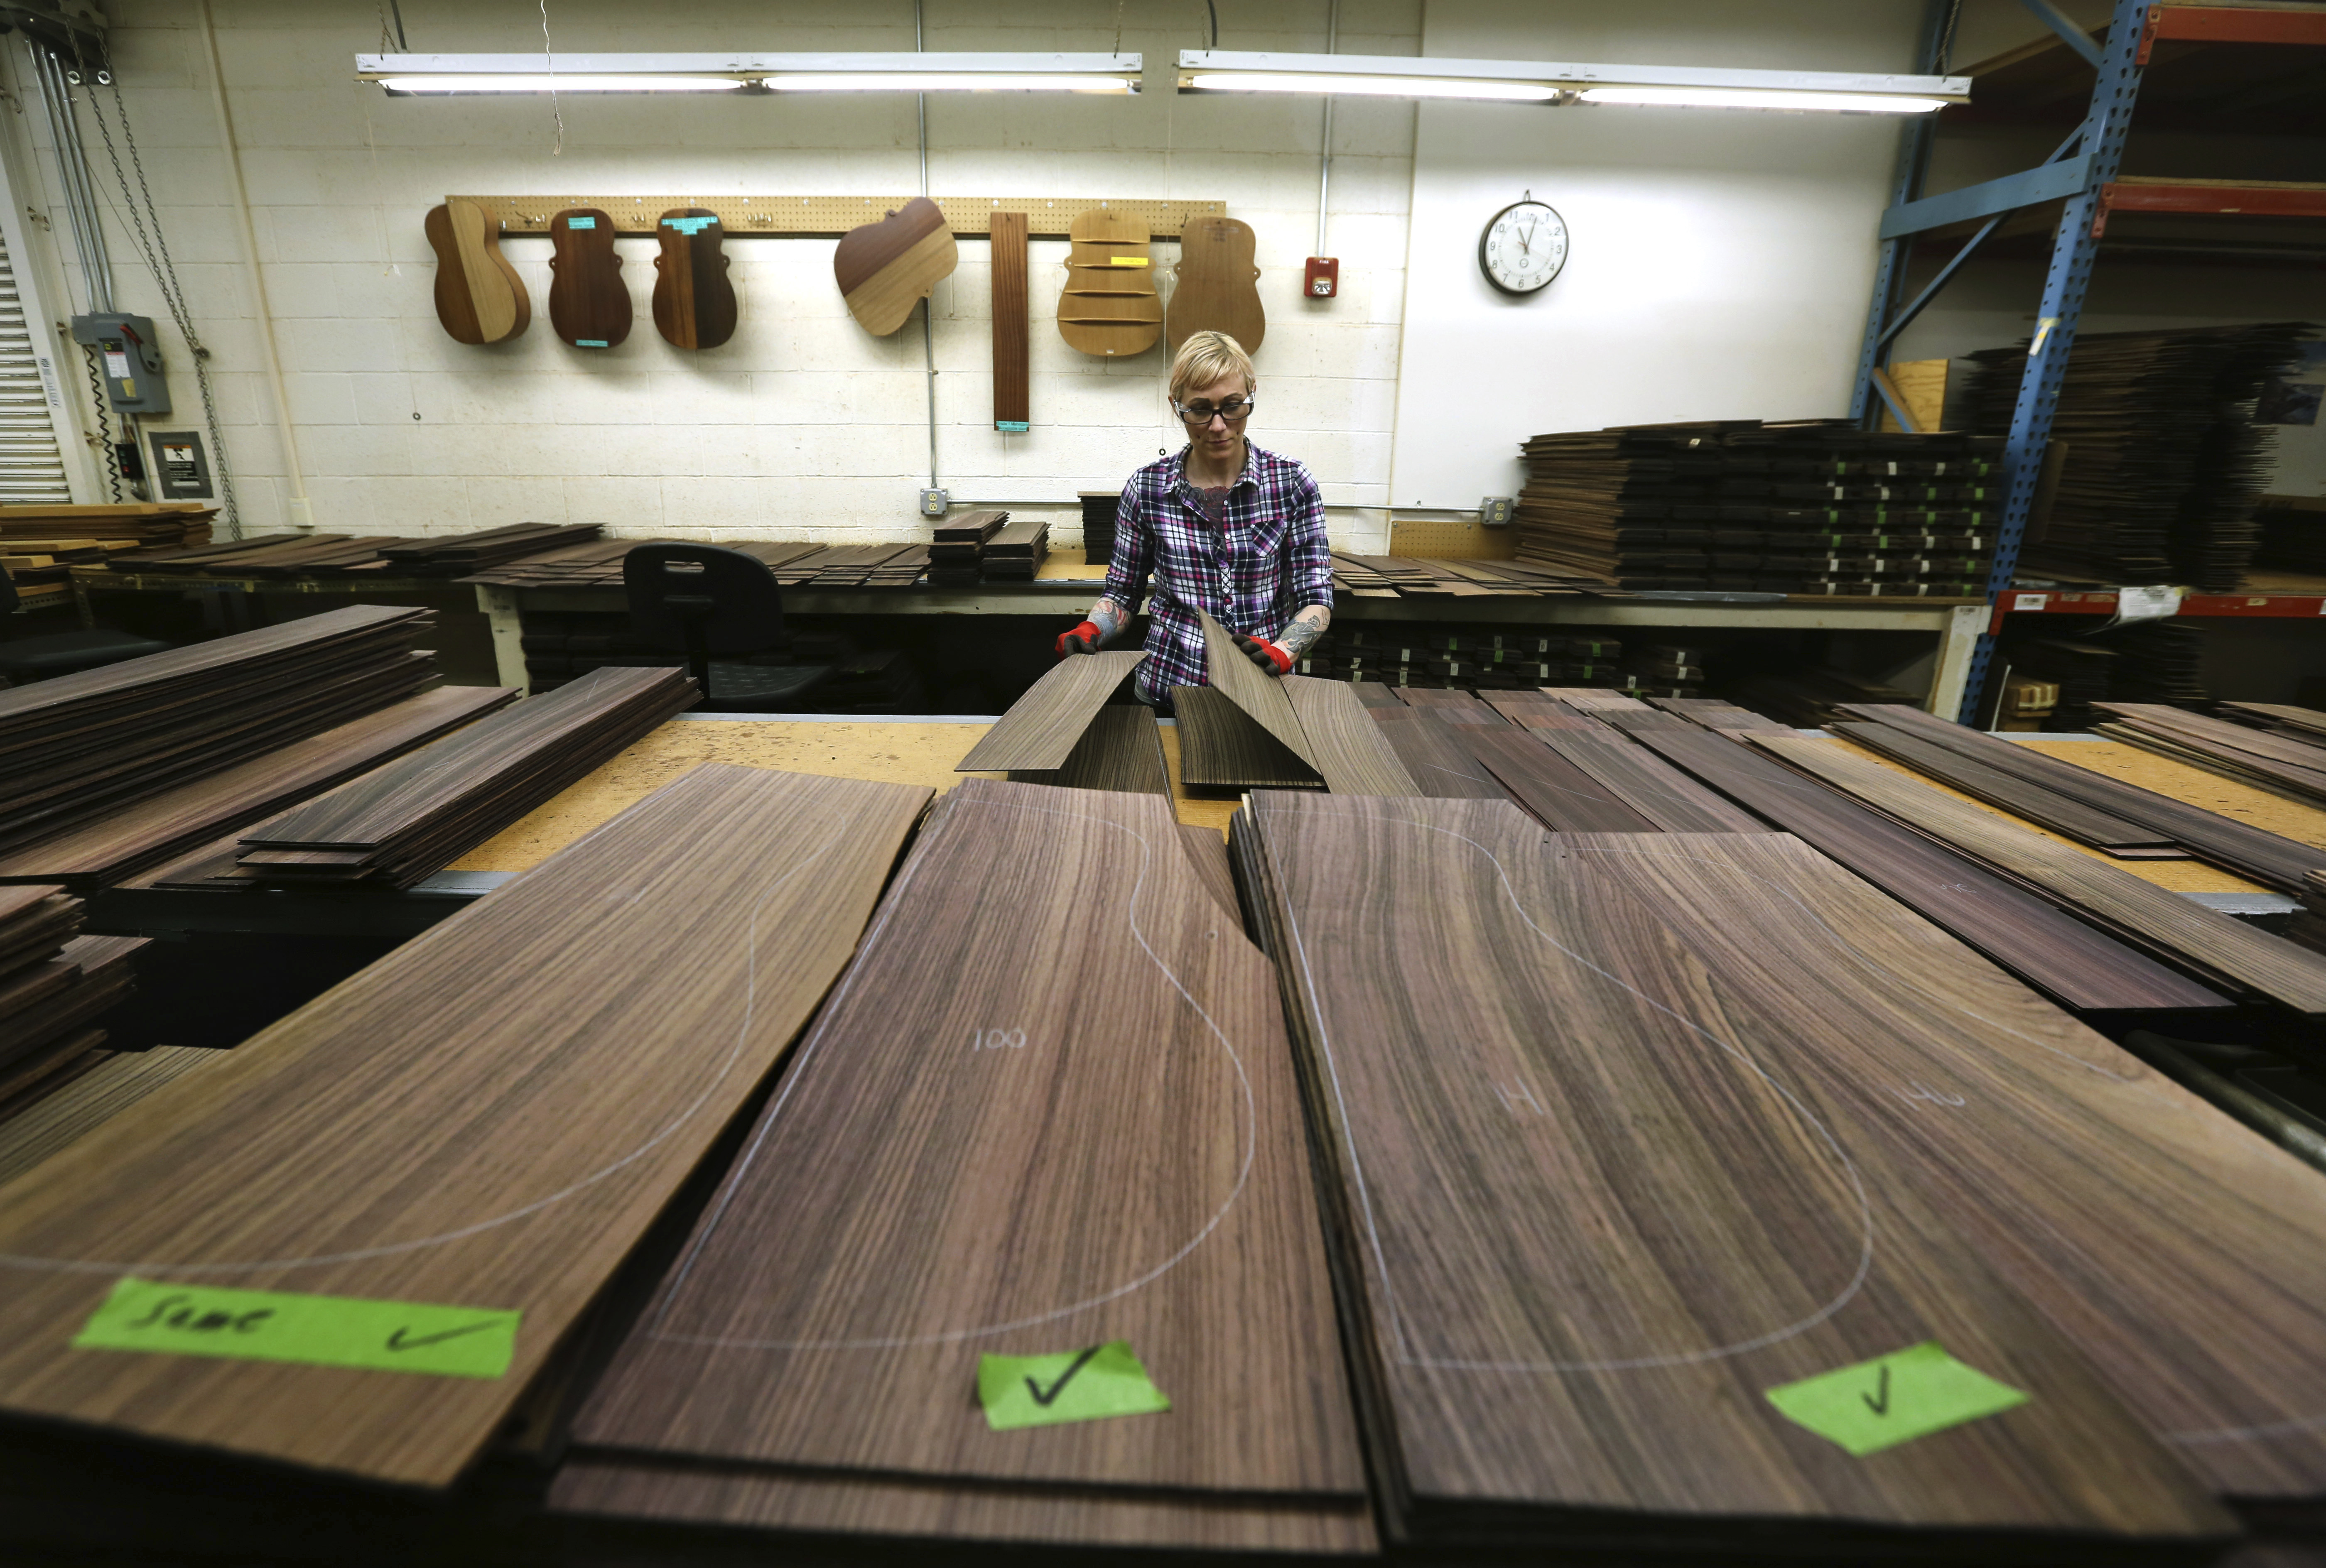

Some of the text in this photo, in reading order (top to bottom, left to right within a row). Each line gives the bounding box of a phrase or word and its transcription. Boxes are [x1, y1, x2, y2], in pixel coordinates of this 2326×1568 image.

[1509, 211, 1518, 219] 11
[1546, 213, 1550, 221] 1
[1495, 223, 1505, 233] 10
[1554, 227, 1560, 235] 2
[1490, 241, 1496, 250] 9
[1556, 244, 1563, 254] 3
[1492, 260, 1498, 268] 8
[1549, 262, 1555, 271] 4
[1503, 273, 1509, 282] 7
[1536, 275, 1541, 284] 5
[1518, 279, 1524, 288] 6
[974, 1027, 1027, 1052] 100
